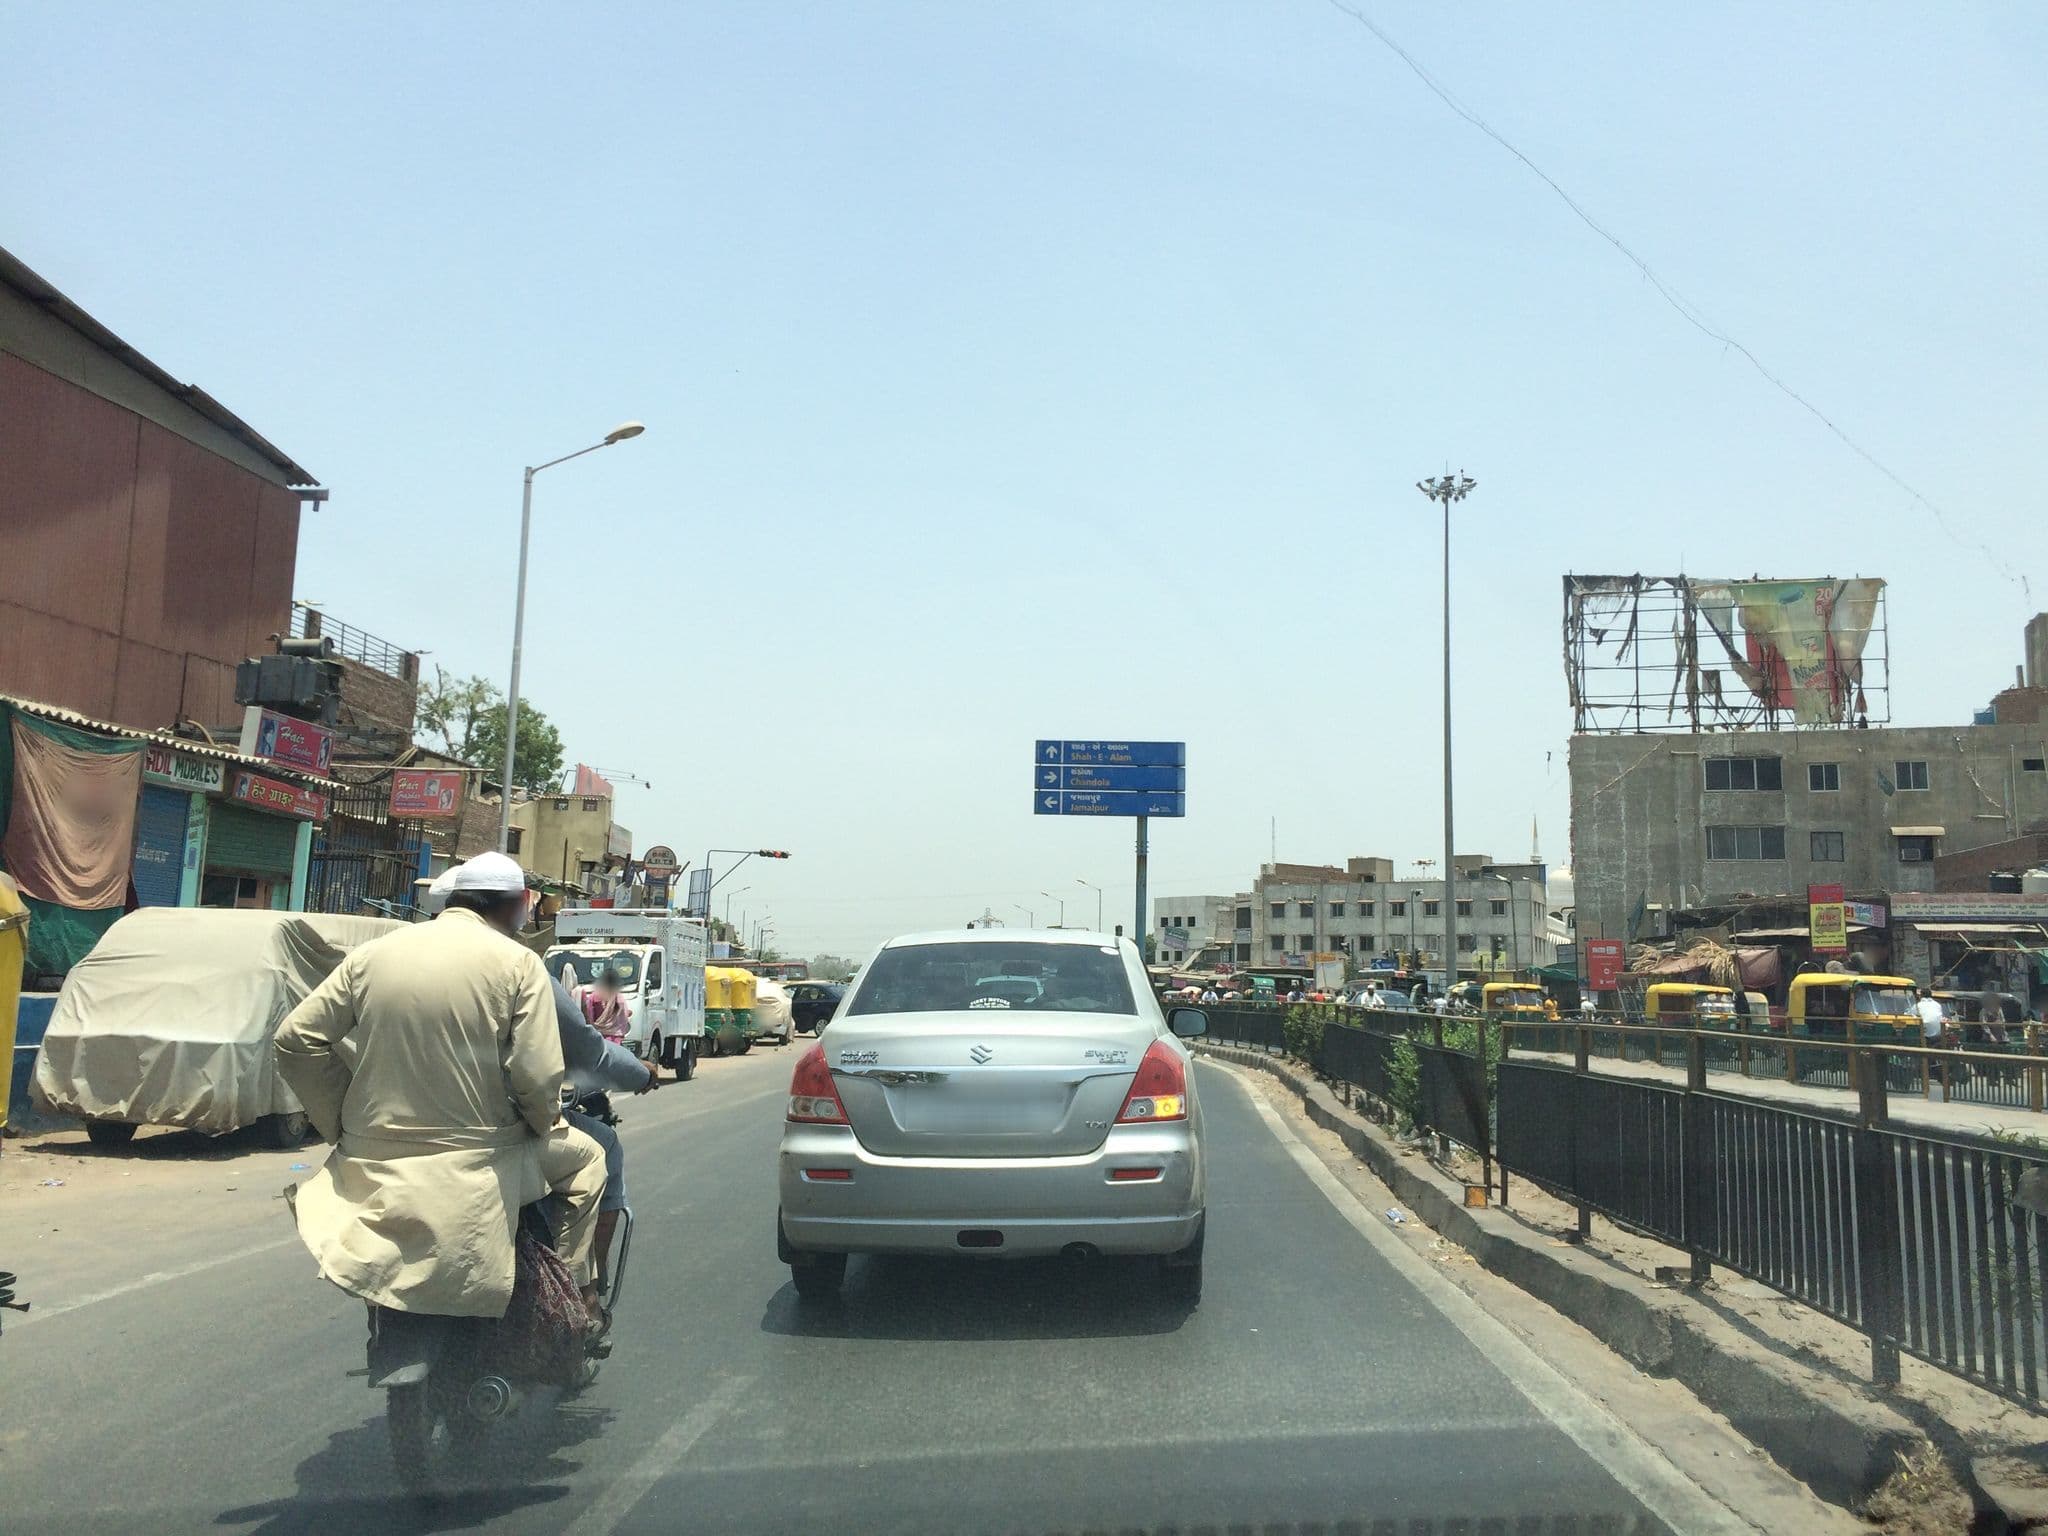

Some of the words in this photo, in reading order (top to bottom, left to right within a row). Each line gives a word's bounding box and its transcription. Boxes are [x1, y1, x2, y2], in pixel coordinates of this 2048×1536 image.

[280, 726, 305, 744] Hair
[1071, 753, 1092, 761] Shah
[1098, 753, 1103, 761] E
[1110, 753, 1132, 761] Alam
[174, 755, 219, 784] MOBILES
[398, 777, 419, 790] Hair
[1071, 777, 1110, 786] Chandola
[1070, 803, 1110, 813] Jamalpur
[576, 927, 593, 935] GOODS
[1084, 1050, 1128, 1058] SWIFT
